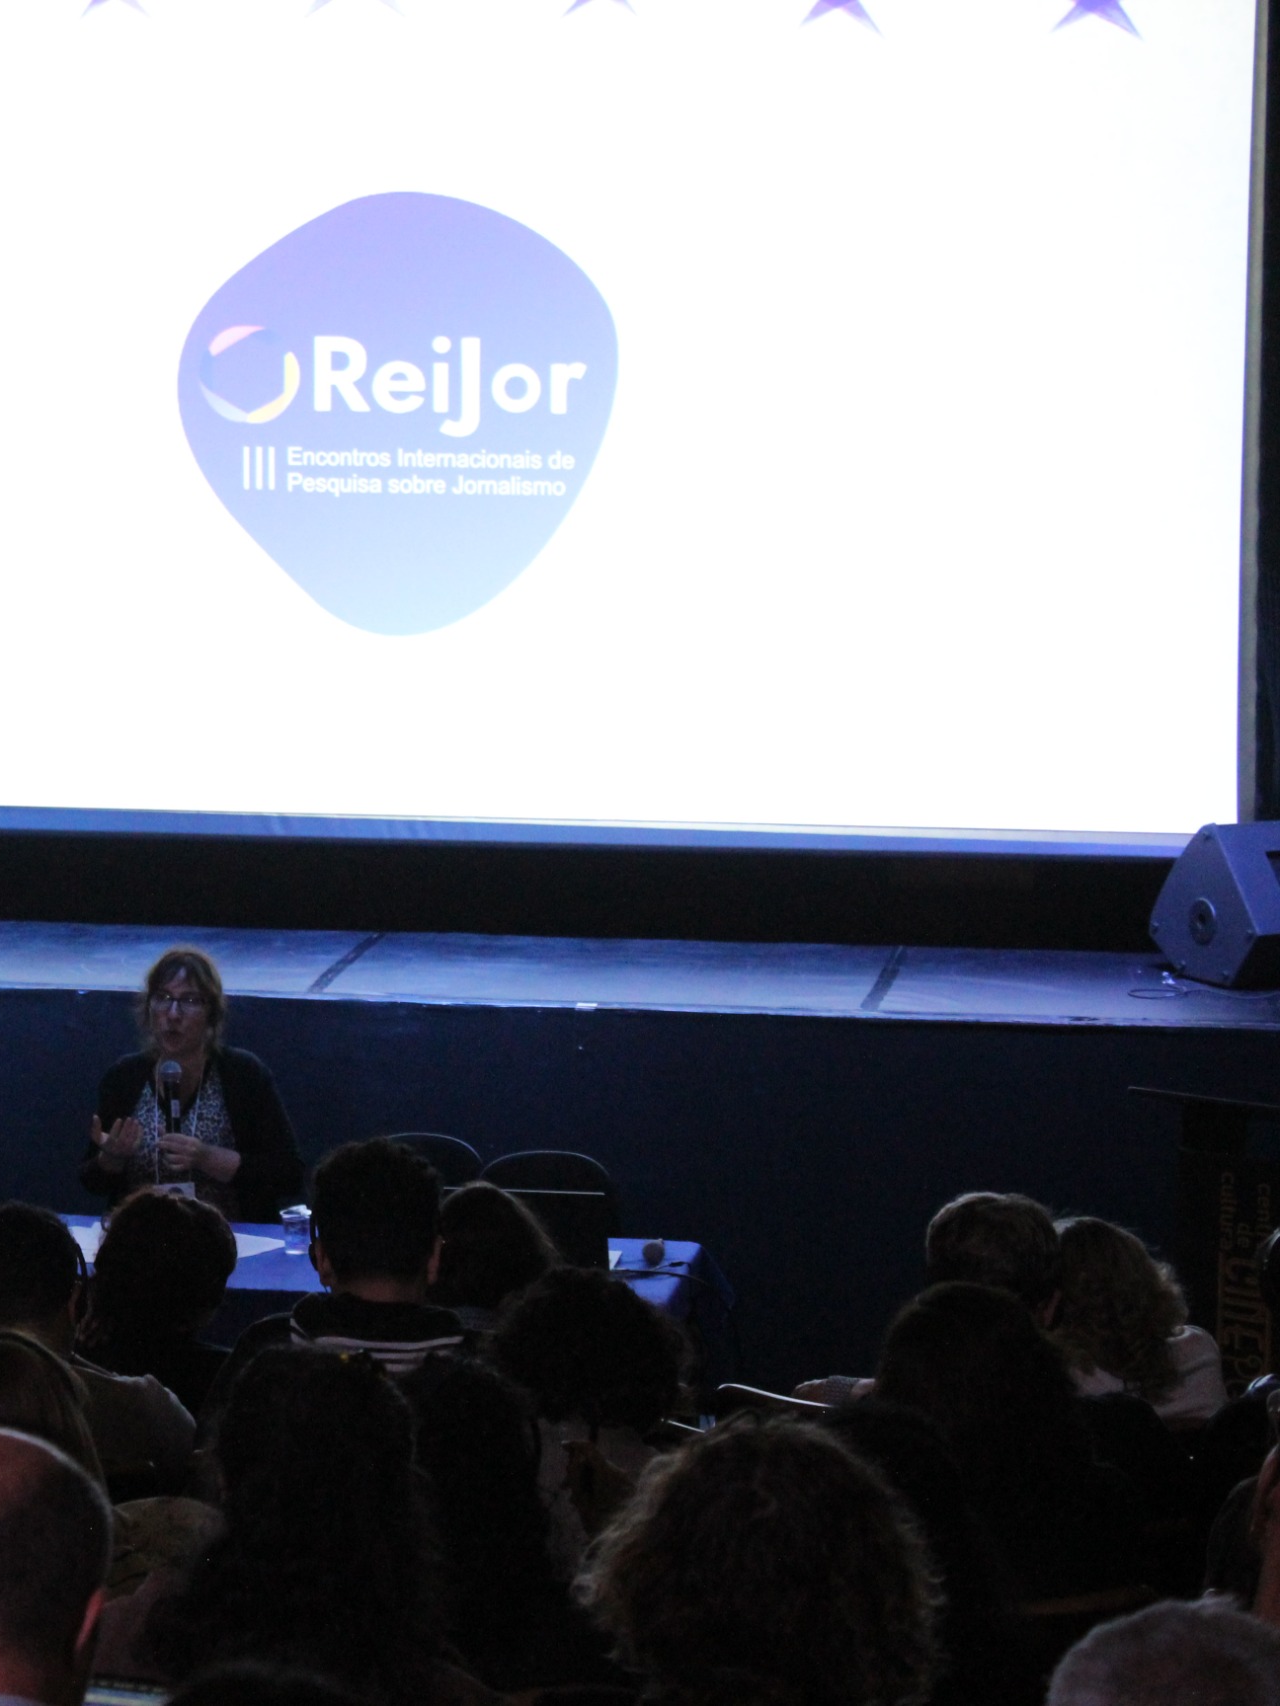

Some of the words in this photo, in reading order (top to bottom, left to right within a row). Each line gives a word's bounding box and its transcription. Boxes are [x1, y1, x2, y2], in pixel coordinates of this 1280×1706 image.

[314, 335, 587, 438] ReiJor
[242, 446, 276, 490] III
[286, 446, 391, 467] Encontros
[397, 447, 543, 469] Internacionais
[548, 450, 575, 469] de
[286, 473, 382, 497] Pesquisa
[388, 474, 446, 495] sobre
[452, 475, 567, 496] Jornalismo
